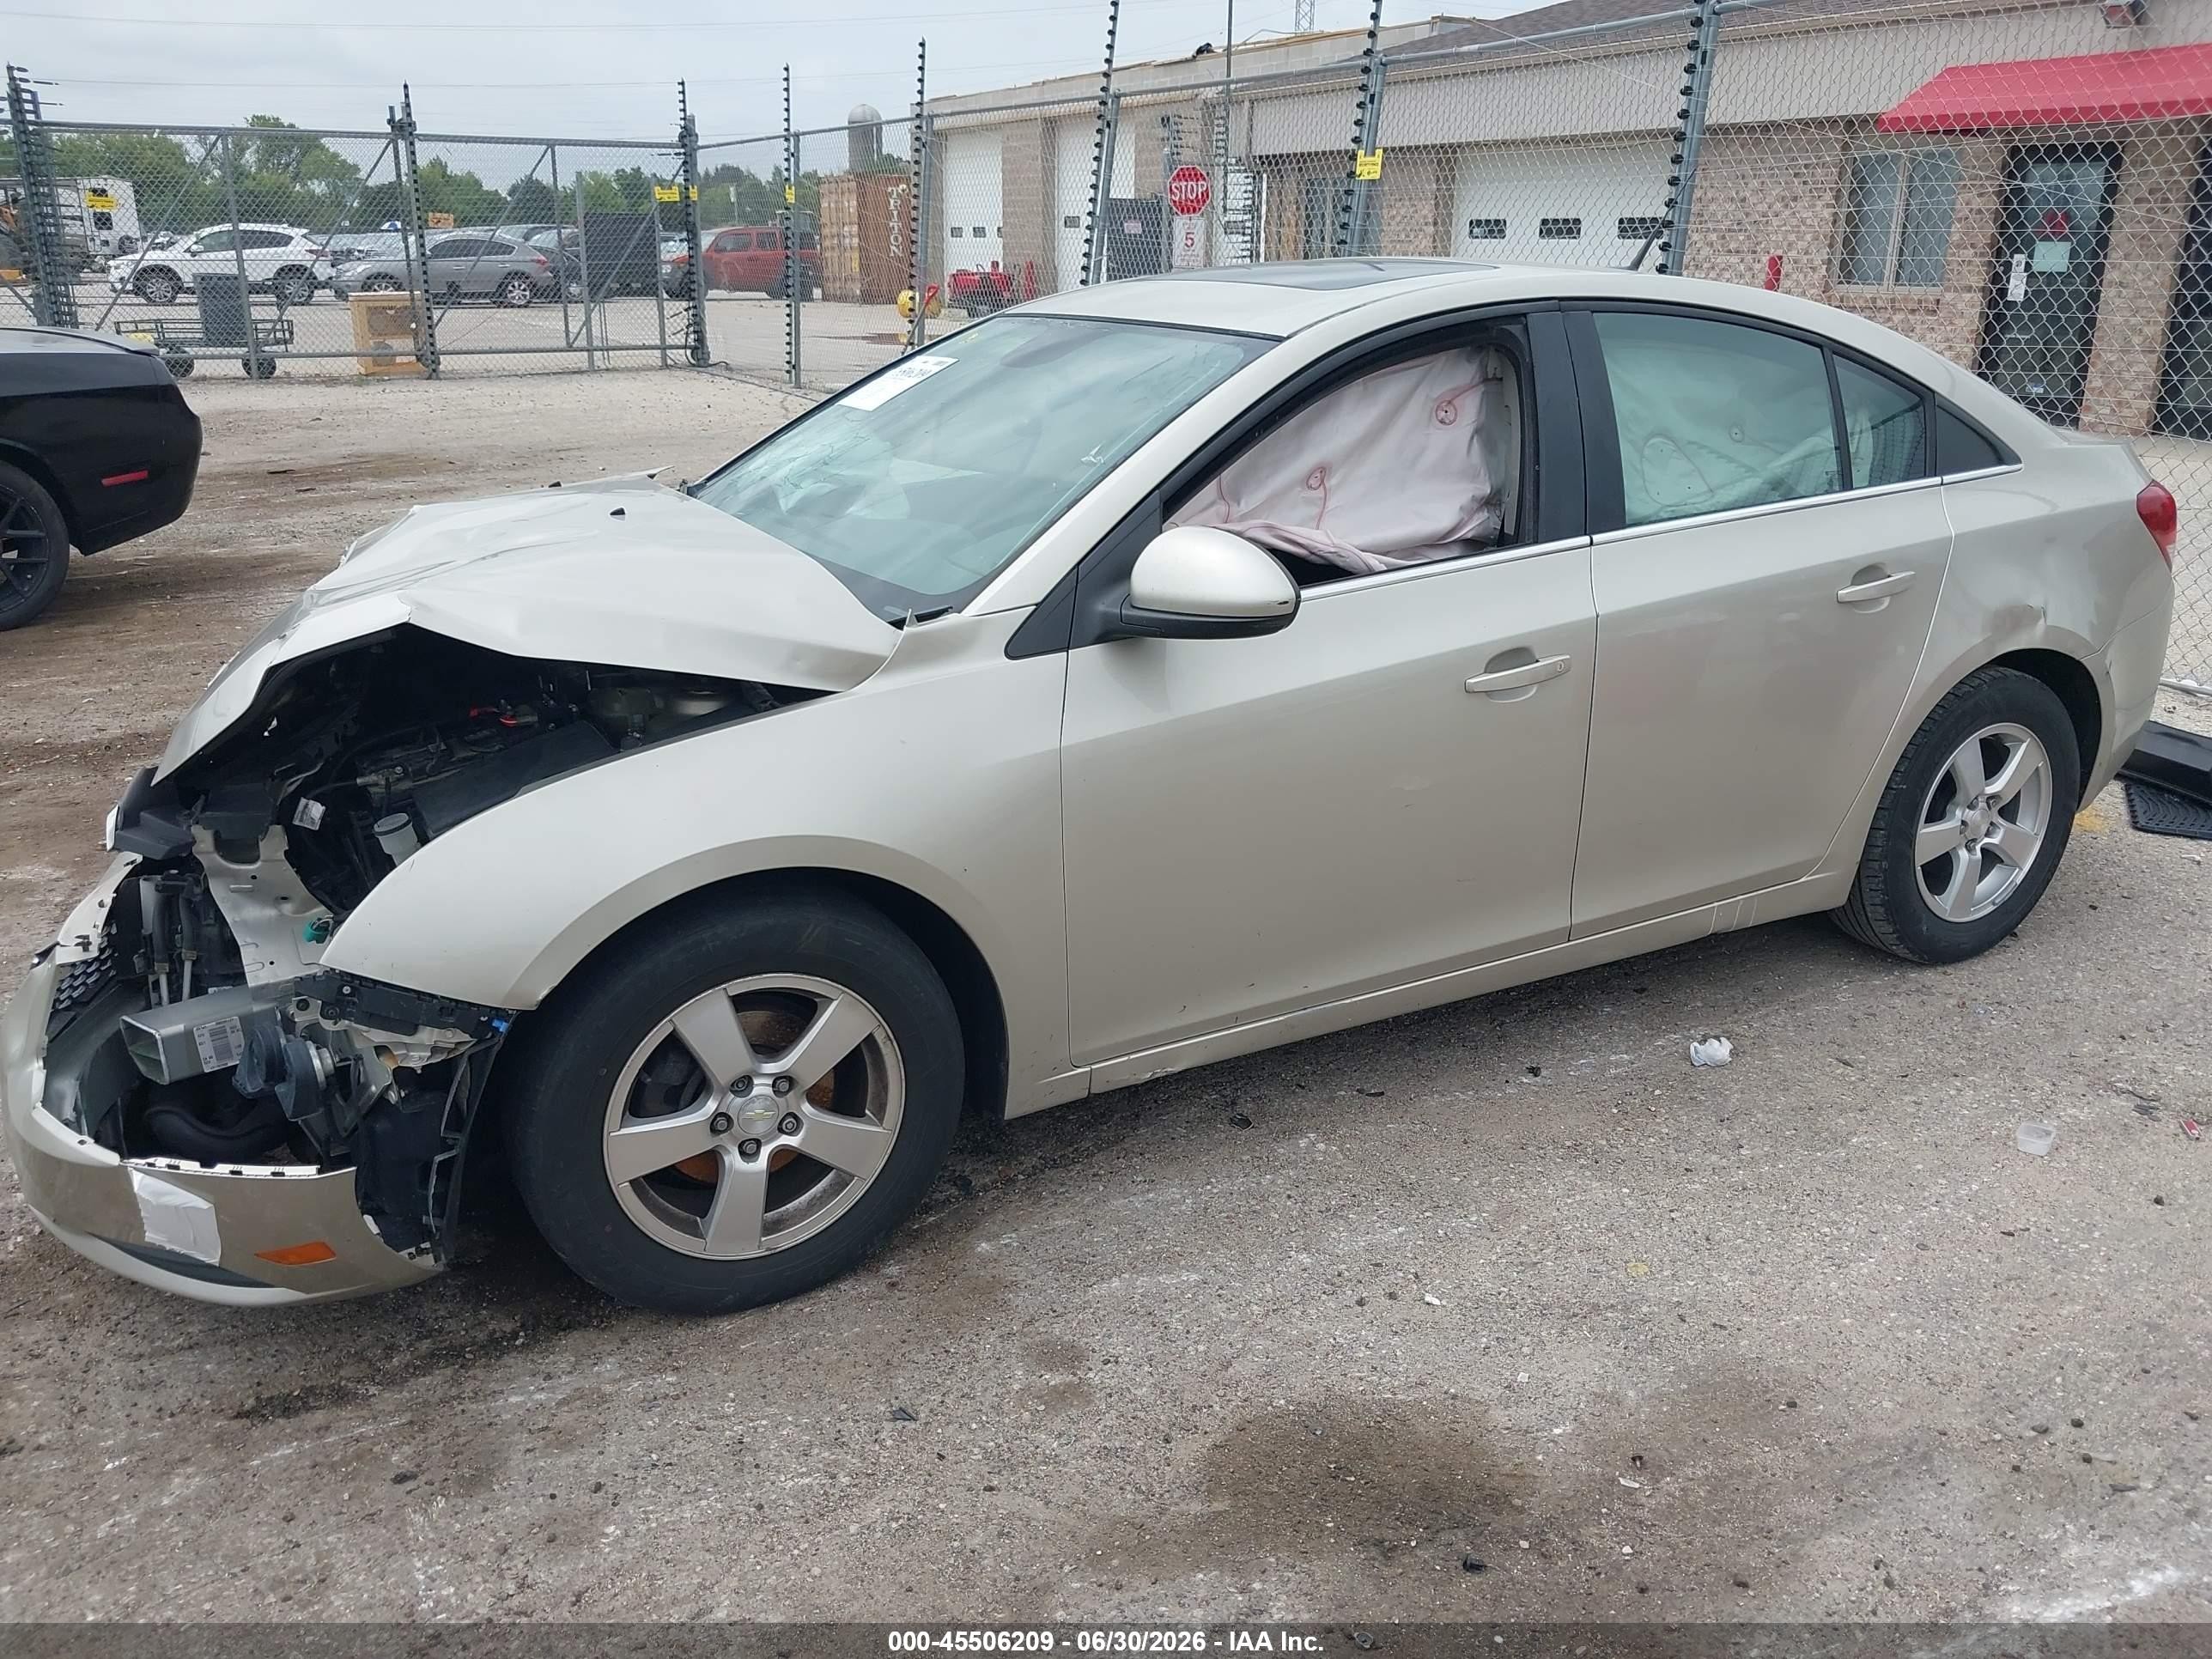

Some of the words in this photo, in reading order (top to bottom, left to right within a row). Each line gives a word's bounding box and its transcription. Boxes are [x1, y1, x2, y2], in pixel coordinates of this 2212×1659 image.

[1171, 181, 1207, 201] STOP
[887, 186, 903, 258] TRITON
[1184, 231, 1195, 248] 5
